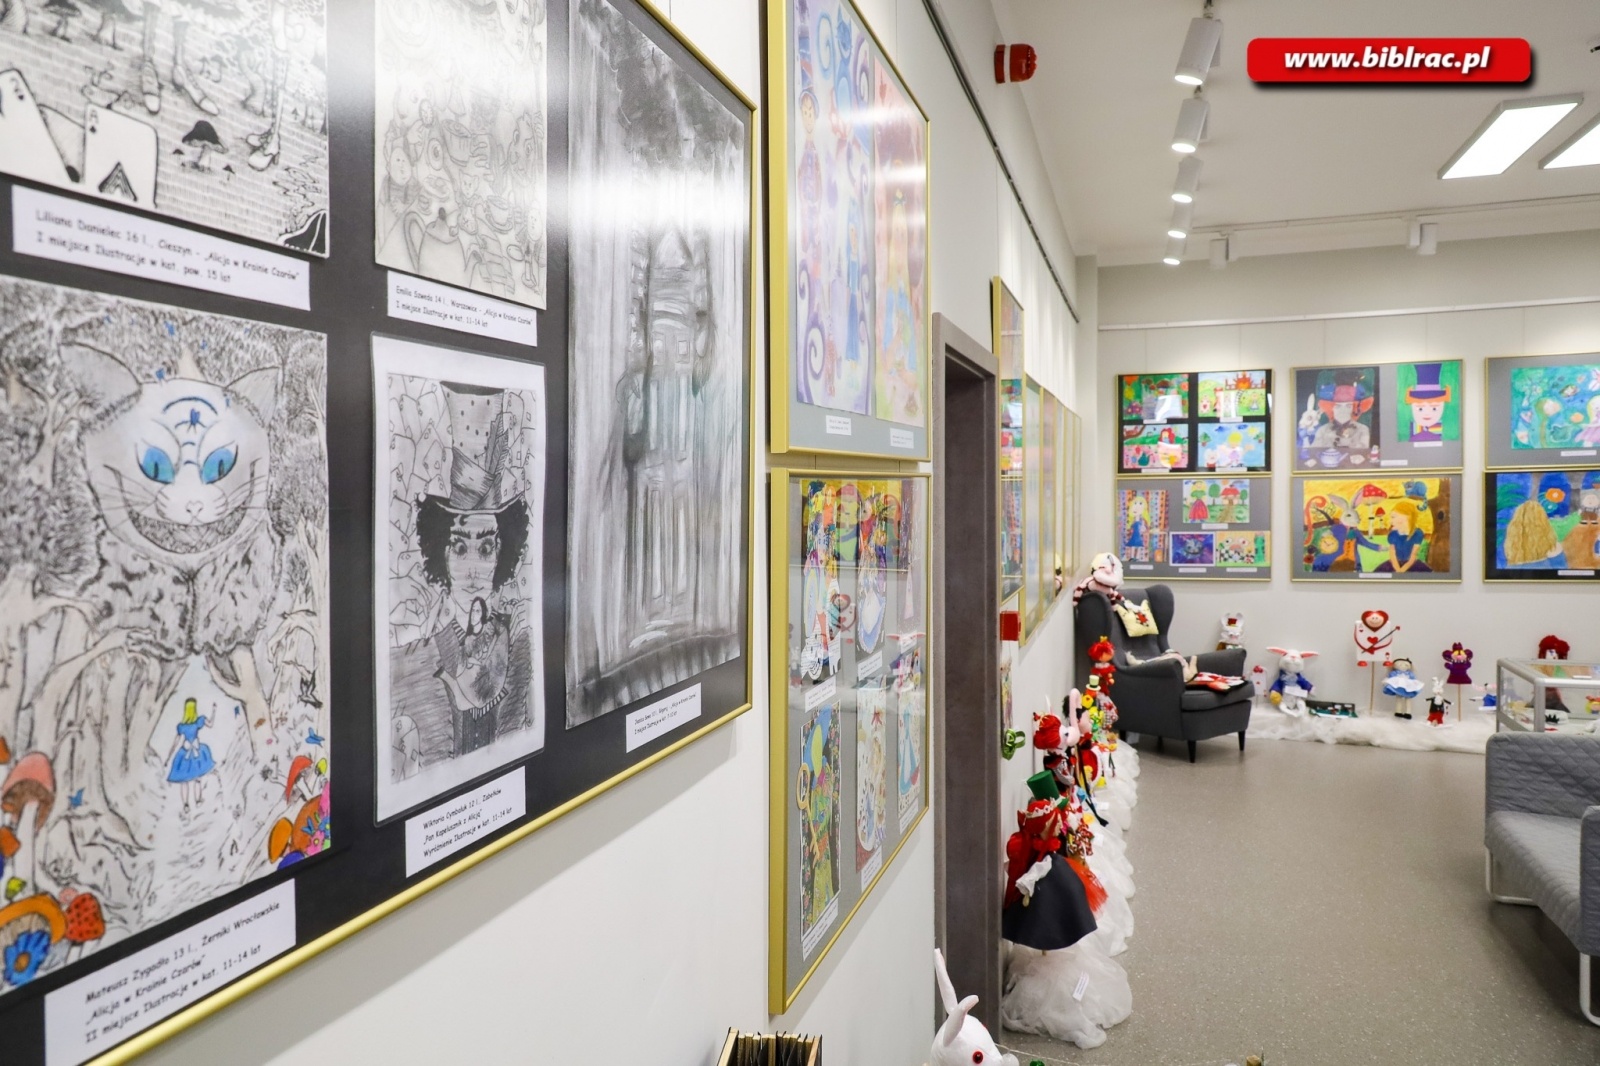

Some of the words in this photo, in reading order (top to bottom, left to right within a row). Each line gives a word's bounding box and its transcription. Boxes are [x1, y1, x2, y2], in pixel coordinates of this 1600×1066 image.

[36, 210, 72, 228] Lilliana
[78, 219, 121, 239] Danielec
[127, 231, 139, 243] 16
[159, 239, 192, 256] Cieszyn
[243, 261, 268, 274] Krainie
[49, 237, 90, 253] miejsce
[95, 244, 146, 266] Ilustracje
[161, 259, 178, 270] kat.
[184, 266, 202, 276] pow.
[423, 307, 448, 320] Ilustracje
[423, 816, 444, 829] Wiktoria
[436, 820, 462, 837] Kapelusznik
[454, 827, 476, 842] Ilustracje
[493, 810, 505, 822] 11-14
[86, 978, 128, 1003] Mateusz
[133, 958, 169, 981] Zygadło
[174, 948, 184, 960] 13
[202, 927, 230, 946] Żerniki
[234, 903, 279, 930] Wrocławskie
[86, 1029, 97, 1044] II
[103, 1011, 139, 1034] miejsce
[144, 984, 188, 1013] Ilustracje
[202, 969, 218, 981] kat.
[224, 951, 247, 970] 11-14
[251, 945, 261, 955] lat
[135, 977, 167, 998] Krainie
